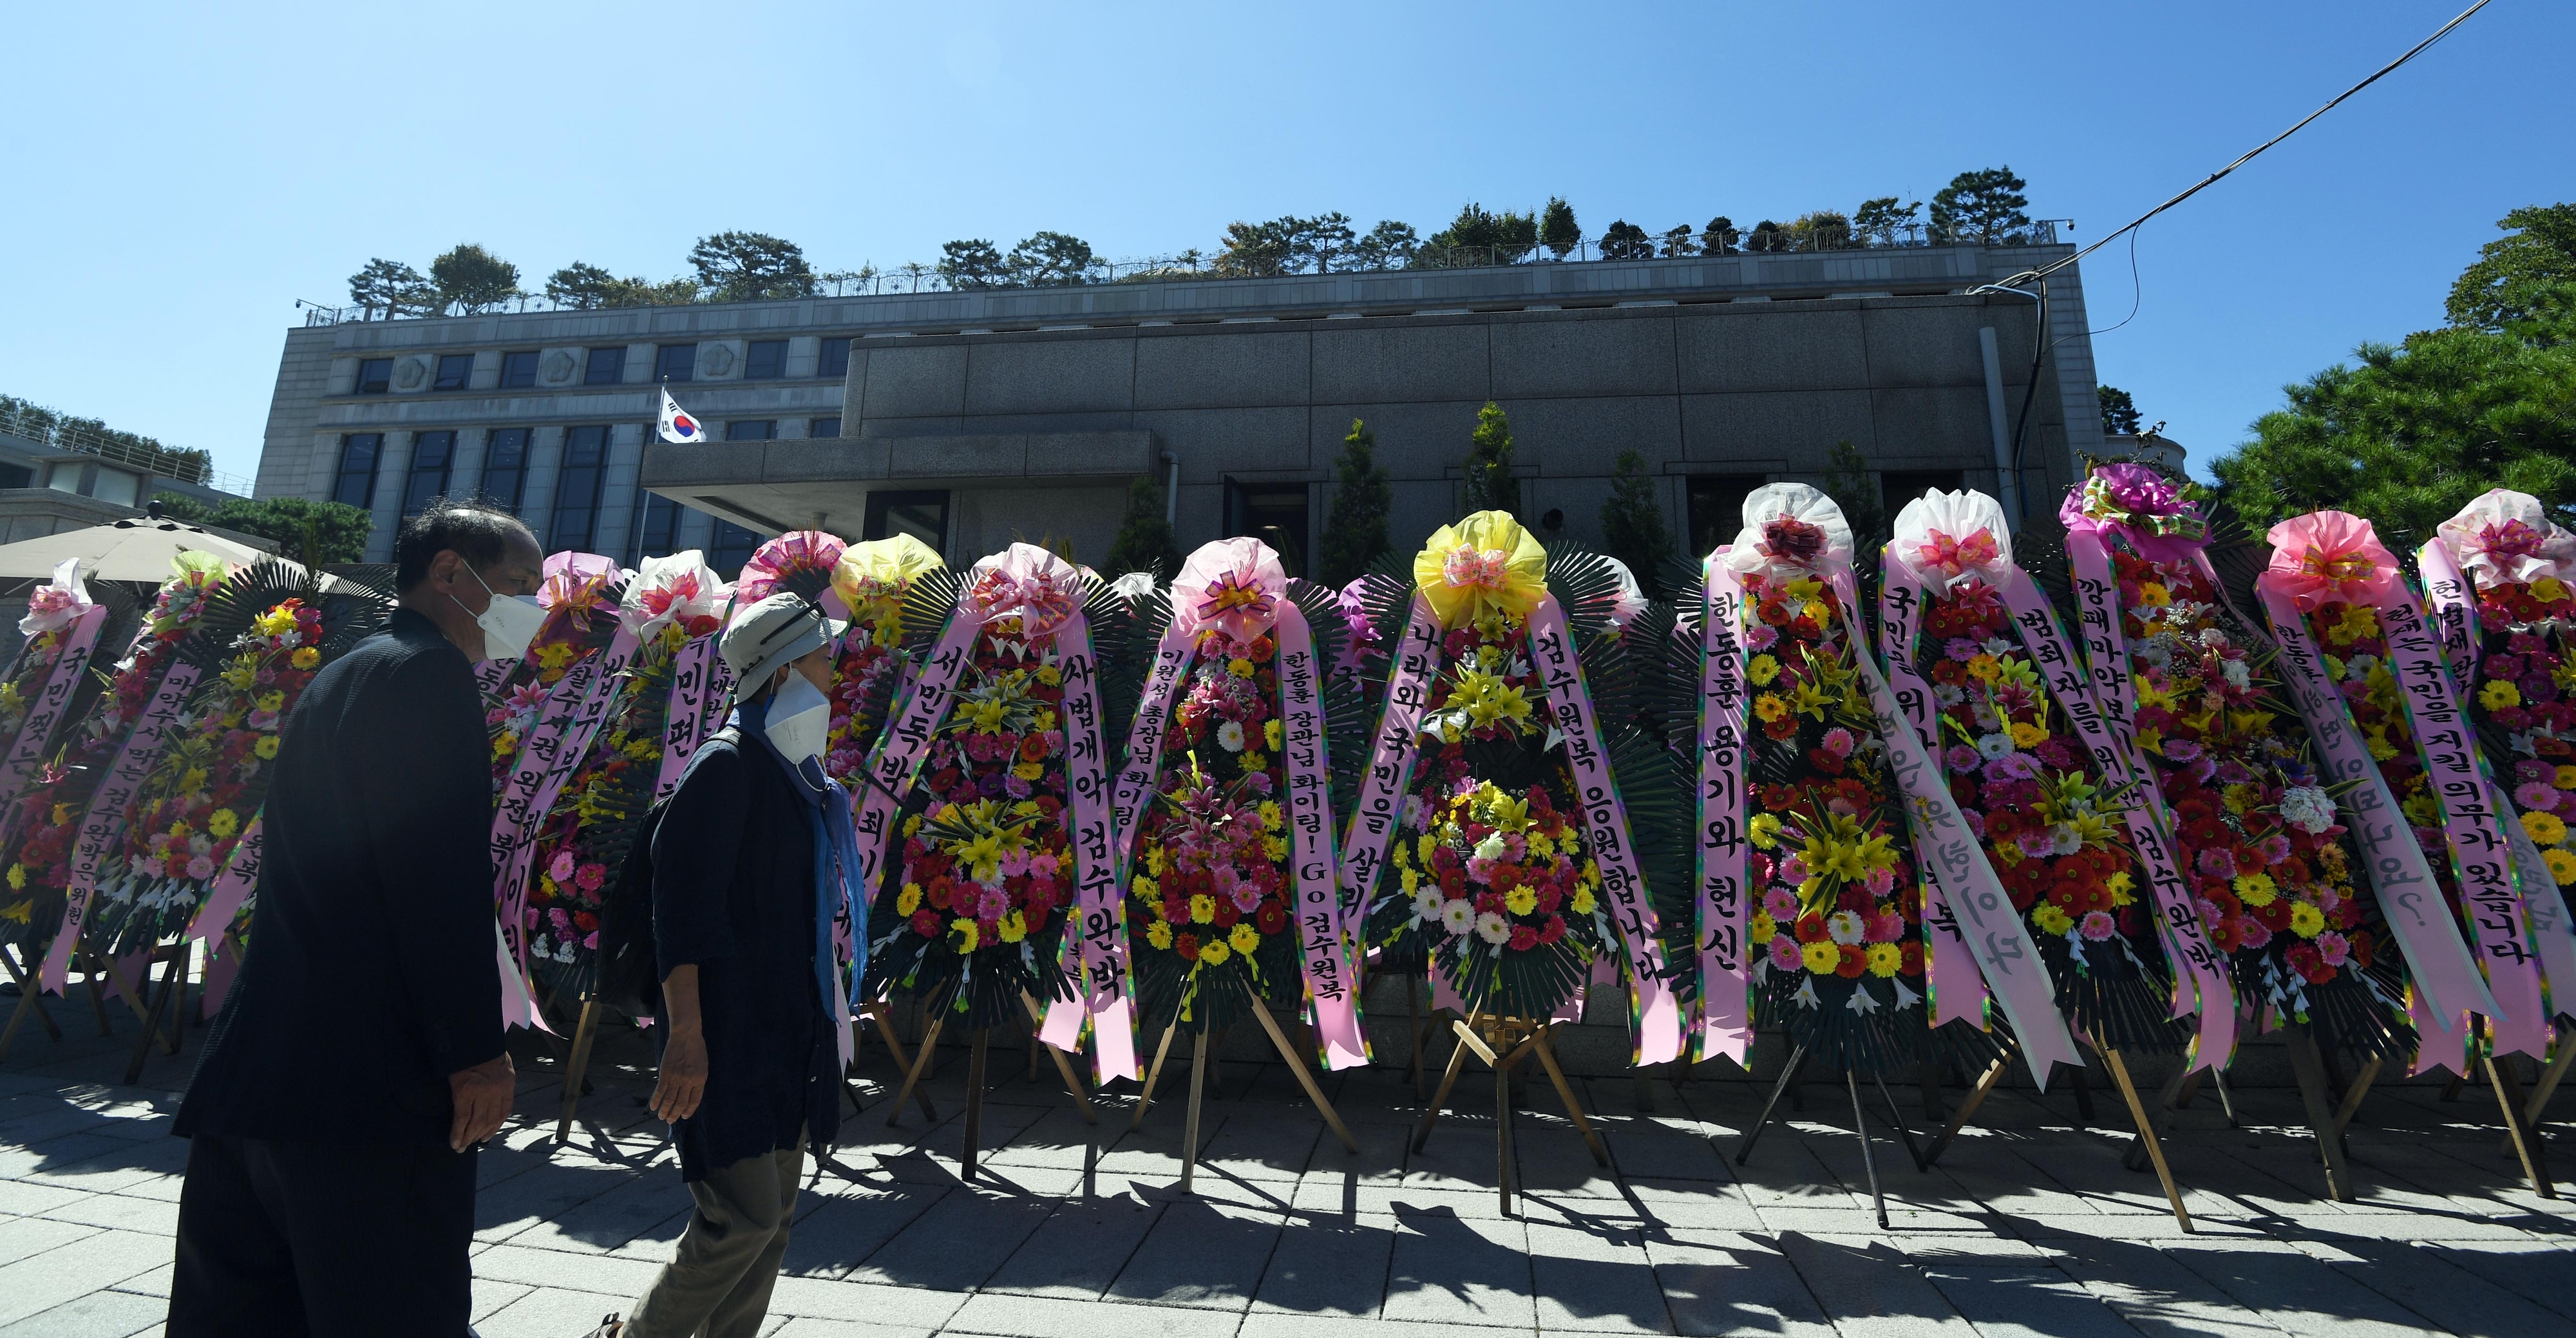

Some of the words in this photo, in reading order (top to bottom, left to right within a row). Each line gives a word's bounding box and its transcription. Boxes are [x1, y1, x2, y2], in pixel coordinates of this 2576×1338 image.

[1392, 623, 1439, 715] 나라와
[1707, 591, 1743, 710] 한동훈
[1884, 586, 1918, 677] 국민을
[2383, 603, 2434, 652] 헌재는
[1155, 650, 1184, 701] 이원석
[1282, 652, 1315, 704] 한동훈
[2406, 659, 2459, 723] 국민을
[551, 654, 625, 791] 법무부
[1063, 654, 1106, 807] 사법개악
[1134, 706, 1165, 764] 총장님
[1285, 711, 1320, 769] 장관님
[2424, 730, 2472, 773] 지킬
[501, 771, 544, 824] 완전
[1291, 774, 1324, 854] 화이팅!
[1361, 728, 1413, 835] 국민을
[1539, 632, 1598, 773] 검수원복
[1584, 786, 1662, 990] 응원합니다
[1703, 725, 1745, 860] 용기와
[2016, 608, 2102, 735] 범죄자를
[2137, 826, 2221, 981] 검수완박
[2443, 780, 2504, 851] 의무가
[69, 885, 88, 926] 위헌
[1079, 821, 1126, 1000] 검수완박
[1703, 875, 1738, 970] 헌신
[2465, 861, 2533, 965] 있습니다
[1304, 912, 1347, 1003] 검수원복
